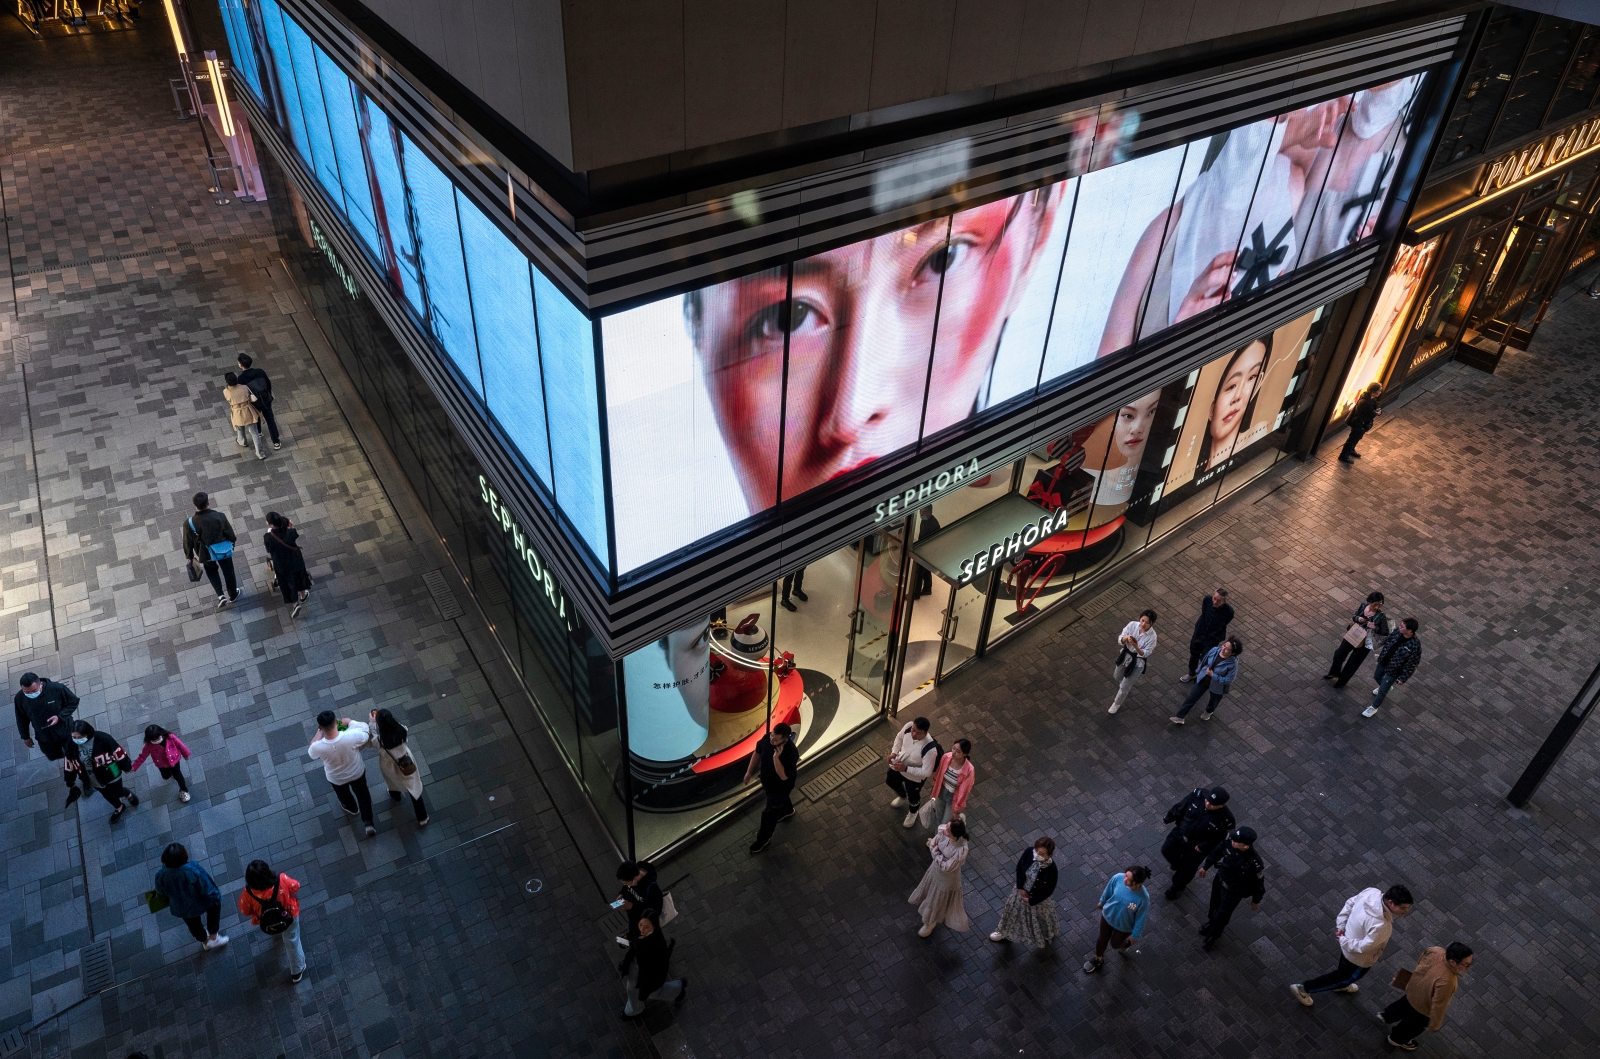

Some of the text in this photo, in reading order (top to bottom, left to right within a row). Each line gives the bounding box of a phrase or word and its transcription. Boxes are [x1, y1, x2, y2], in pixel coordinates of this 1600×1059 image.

[1480, 118, 1600, 196] POLO RALP
[874, 457, 980, 523] SEPHORA
[959, 507, 1069, 583] SEPHORA
[748, 639, 769, 652] SEPHORA
